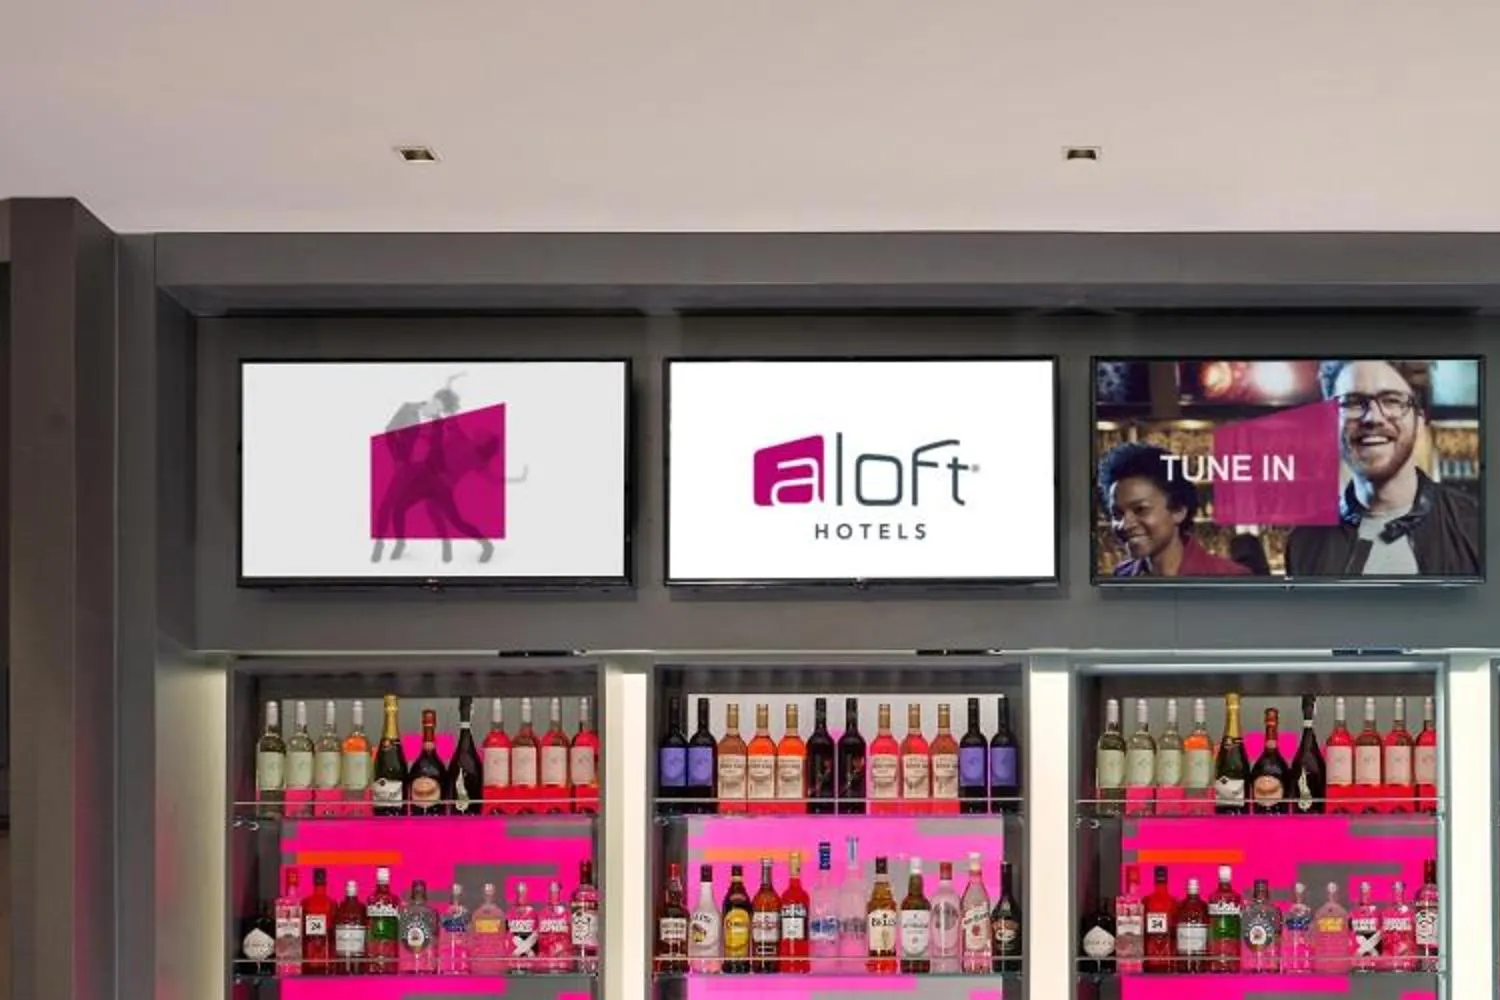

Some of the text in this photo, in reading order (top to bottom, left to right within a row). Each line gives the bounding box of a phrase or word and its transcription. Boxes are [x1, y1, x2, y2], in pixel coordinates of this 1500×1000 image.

[753, 431, 969, 506] aloft
[1160, 454, 1296, 482] TUNE IN
[814, 522, 928, 541] HOTELS
[310, 921, 322, 931] 24
